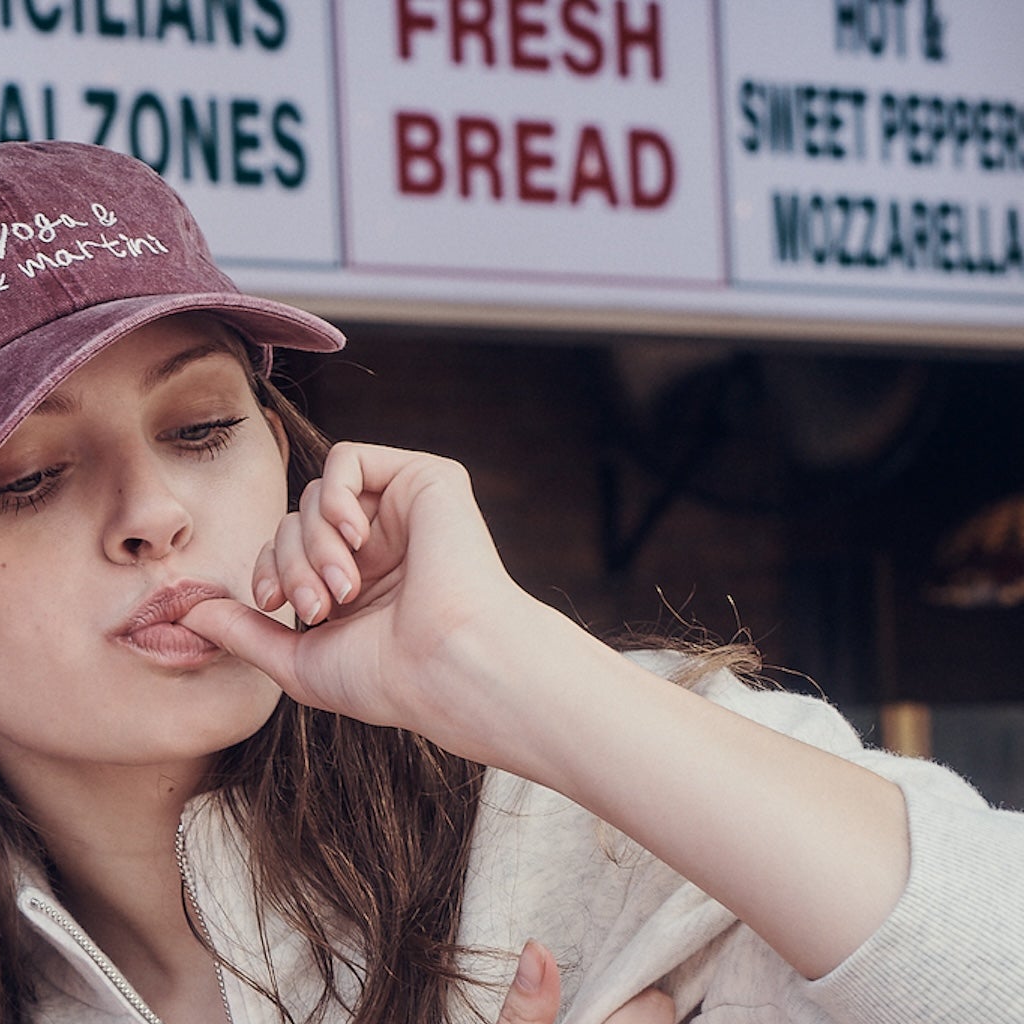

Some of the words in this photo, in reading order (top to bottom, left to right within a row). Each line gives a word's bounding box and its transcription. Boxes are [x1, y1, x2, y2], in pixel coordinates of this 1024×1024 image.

[395, 0, 663, 81] FRESH
[834, 0, 907, 57] HOT
[739, 79, 866, 159] SWEET
[394, 110, 678, 210] BREAD
[91, 203, 117, 227] &
[772, 193, 1024, 275] MOZZARELLA
[18, 233, 169, 278] martini
